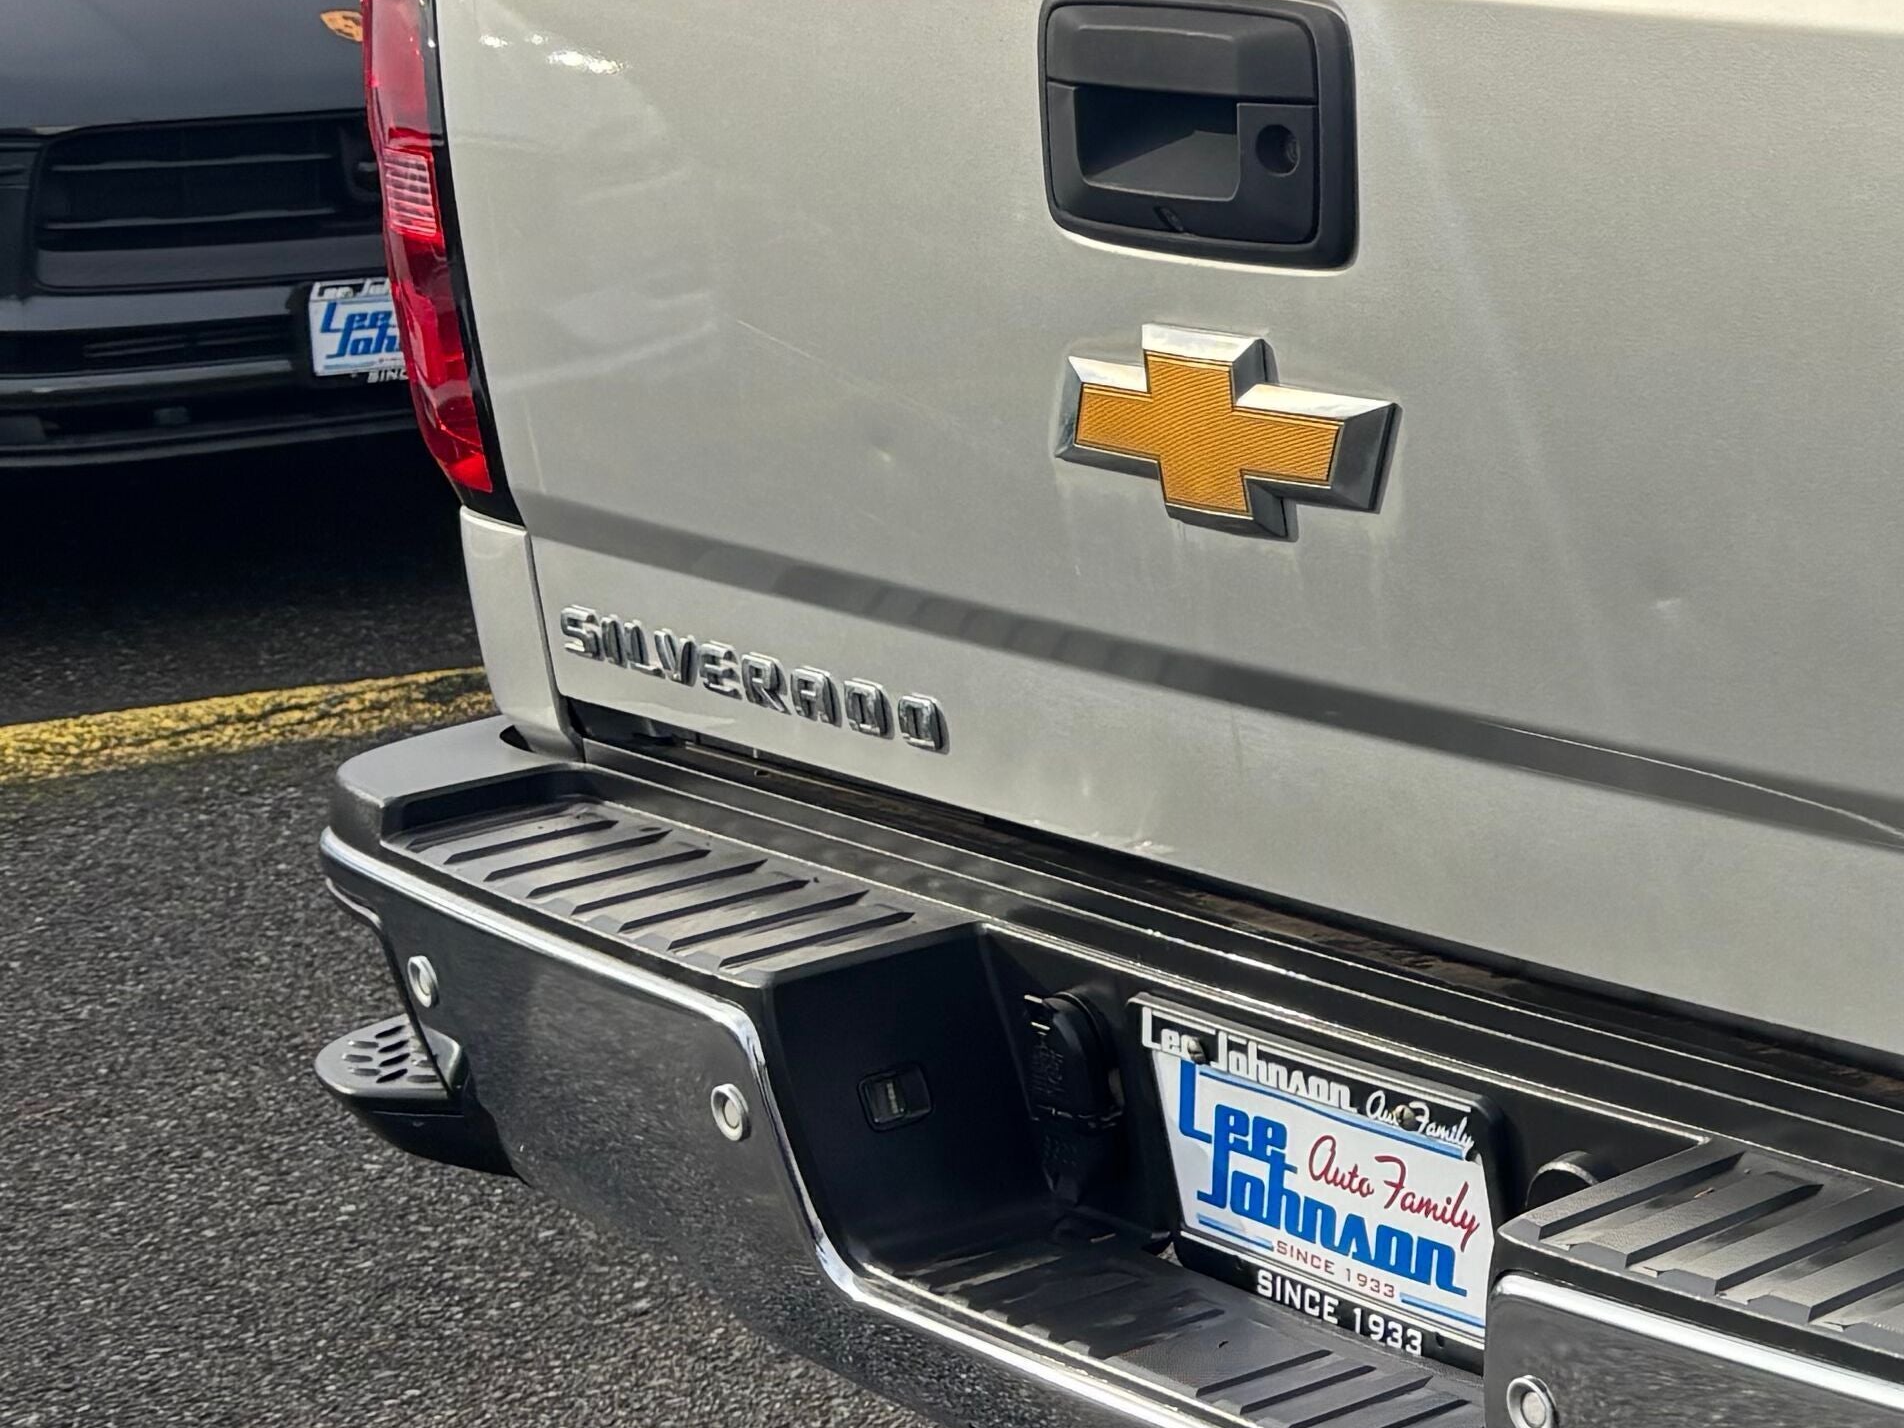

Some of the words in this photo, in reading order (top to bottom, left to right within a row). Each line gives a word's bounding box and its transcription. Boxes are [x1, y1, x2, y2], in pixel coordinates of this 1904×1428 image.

[560, 604, 950, 754] SILVERADO
[1179, 1060, 1292, 1164] Lee
[1408, 1100, 1475, 1160] Family
[1197, 1127, 1467, 1298] Johnson
[1308, 1134, 1394, 1198] Auto
[1375, 1154, 1480, 1252] Family
[1257, 1269, 1339, 1326] SINCE
[1353, 1306, 1423, 1357] 1933
[1275, 1240, 1334, 1276] SINCE
[1345, 1258, 1396, 1299] 1933
